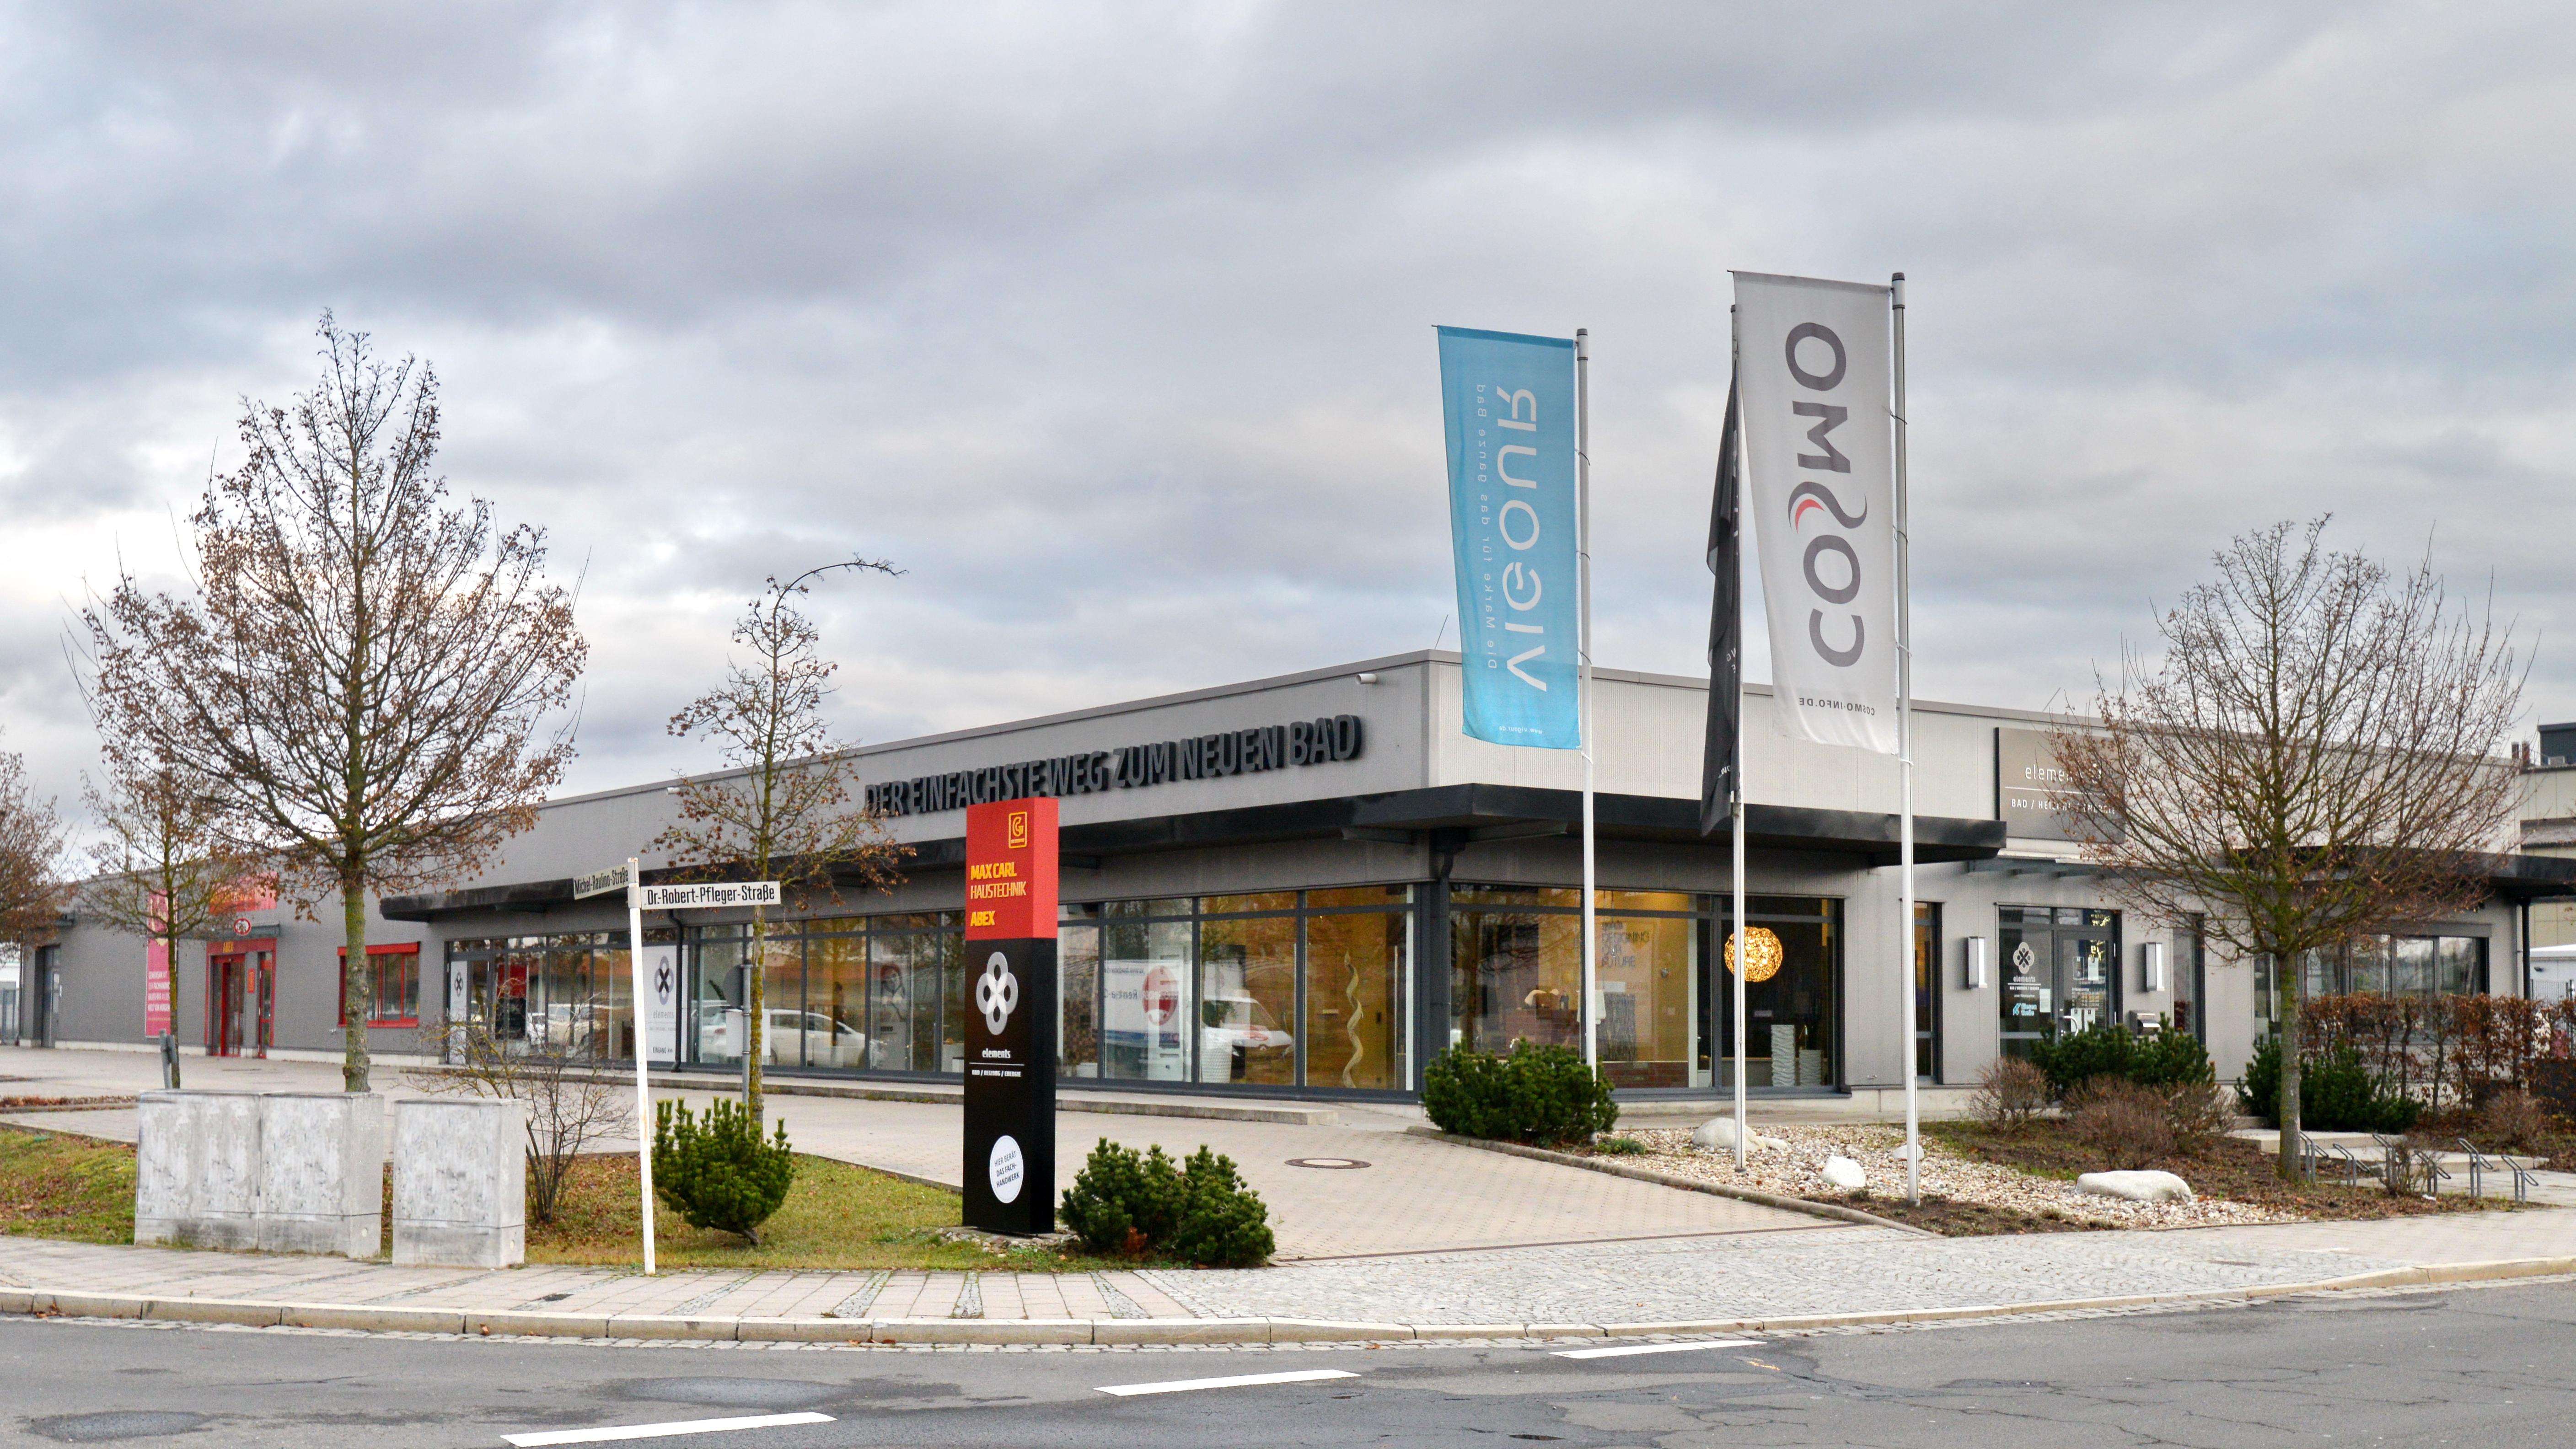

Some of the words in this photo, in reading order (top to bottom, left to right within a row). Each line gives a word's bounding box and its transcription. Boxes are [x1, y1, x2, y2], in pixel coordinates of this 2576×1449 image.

[864, 780, 906, 818] DER
[909, 760, 1043, 813] EINFACHSTE
[1046, 751, 1104, 796] WEG
[1112, 741, 1172, 788] ZUM
[1180, 724, 1282, 779] NEUEN
[1289, 714, 1359, 765] BAD
[2012, 799, 2027, 808] BAD
[971, 864, 993, 880] MAX
[993, 862, 1017, 878] CARL
[574, 867, 628, 895] Michel-Raulino-Straße
[647, 884, 775, 906] Dr.-Robert-Pfleger-Straße
[971, 881, 1027, 900] HAUSTECHNIK
[970, 911, 995, 927] ABEX
[982, 1048, 1011, 1058] elements
[994, 1157, 1004, 1167] HIER
[1005, 1163, 1017, 1173] FACH-
[996, 1172, 1020, 1188] HANDWERK
